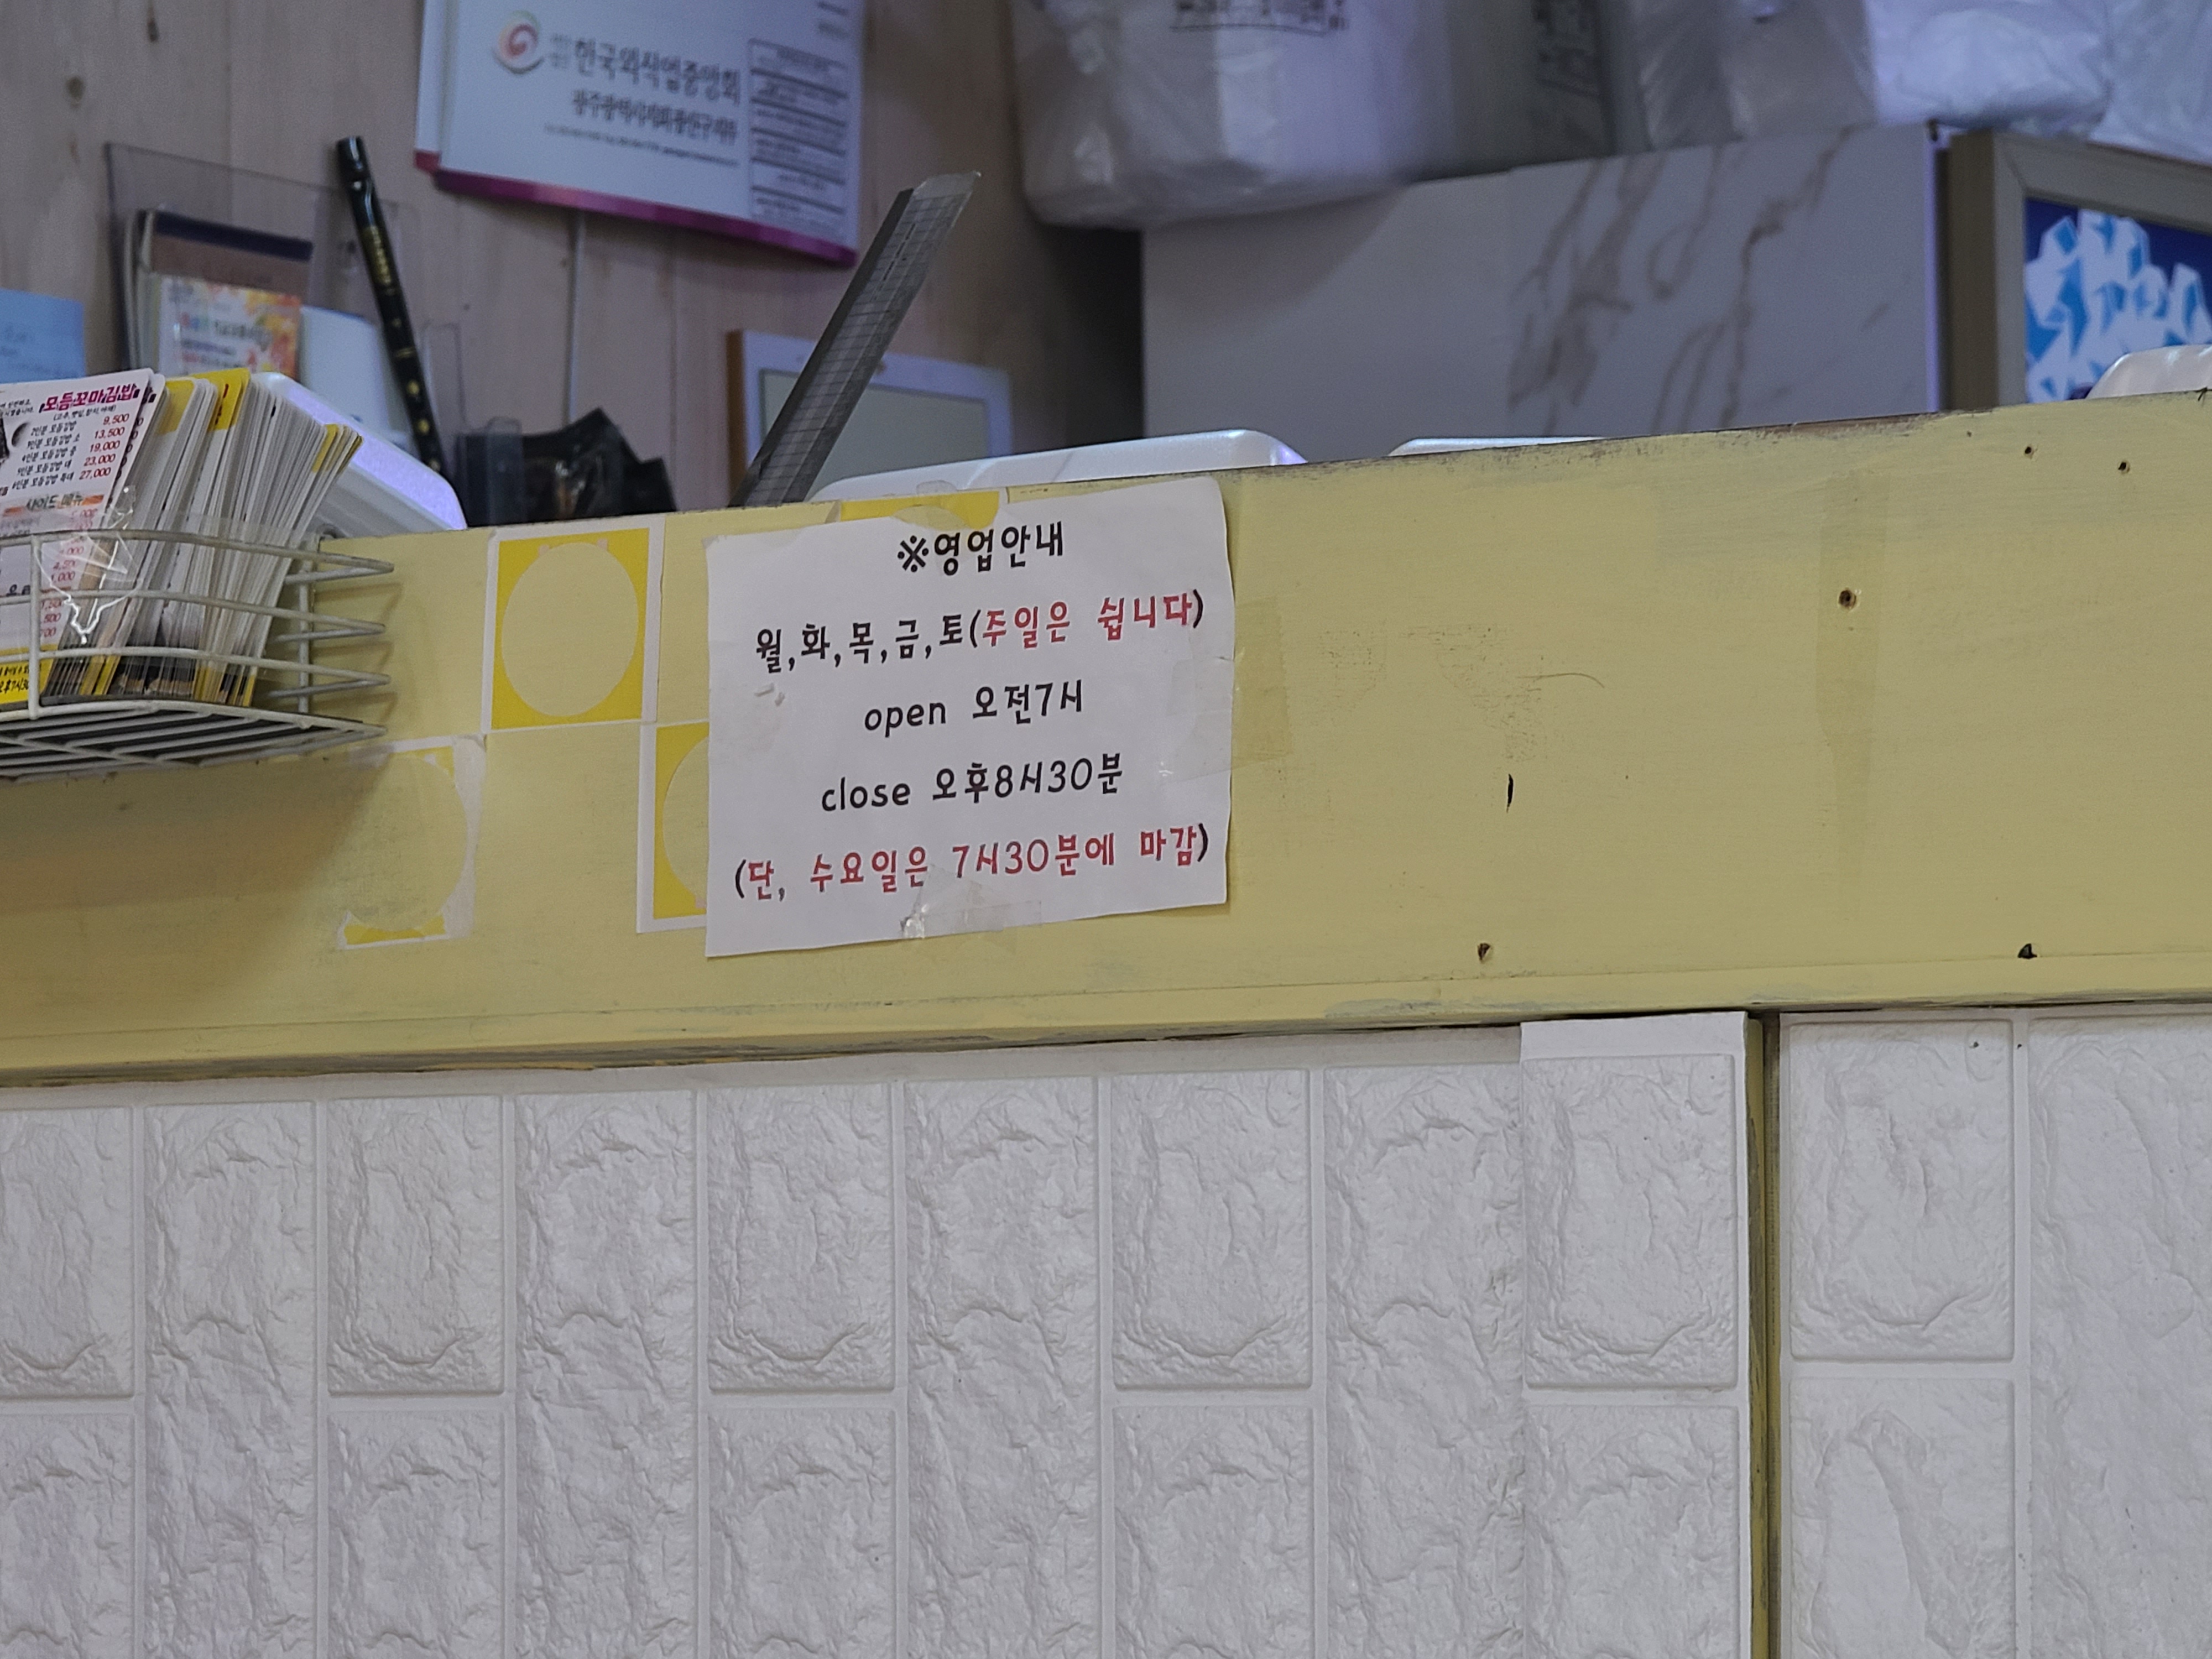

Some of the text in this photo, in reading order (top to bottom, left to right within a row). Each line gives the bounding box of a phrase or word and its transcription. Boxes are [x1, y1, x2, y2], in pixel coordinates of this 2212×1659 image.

[103, 414, 129, 425] 9,500
[95, 427, 125, 439] 13,500
[90, 440, 121, 452] 19,000
[84, 453, 116, 466] 23,000
[79, 467, 111, 480] 27,000
[1098, 588, 1204, 641] 쉽니다)
[864, 679, 1082, 738] open 오전7시
[822, 753, 1123, 812] close 오후8시30분
[735, 823, 1208, 901] (단, 수요일은 7시30분에 마감)
